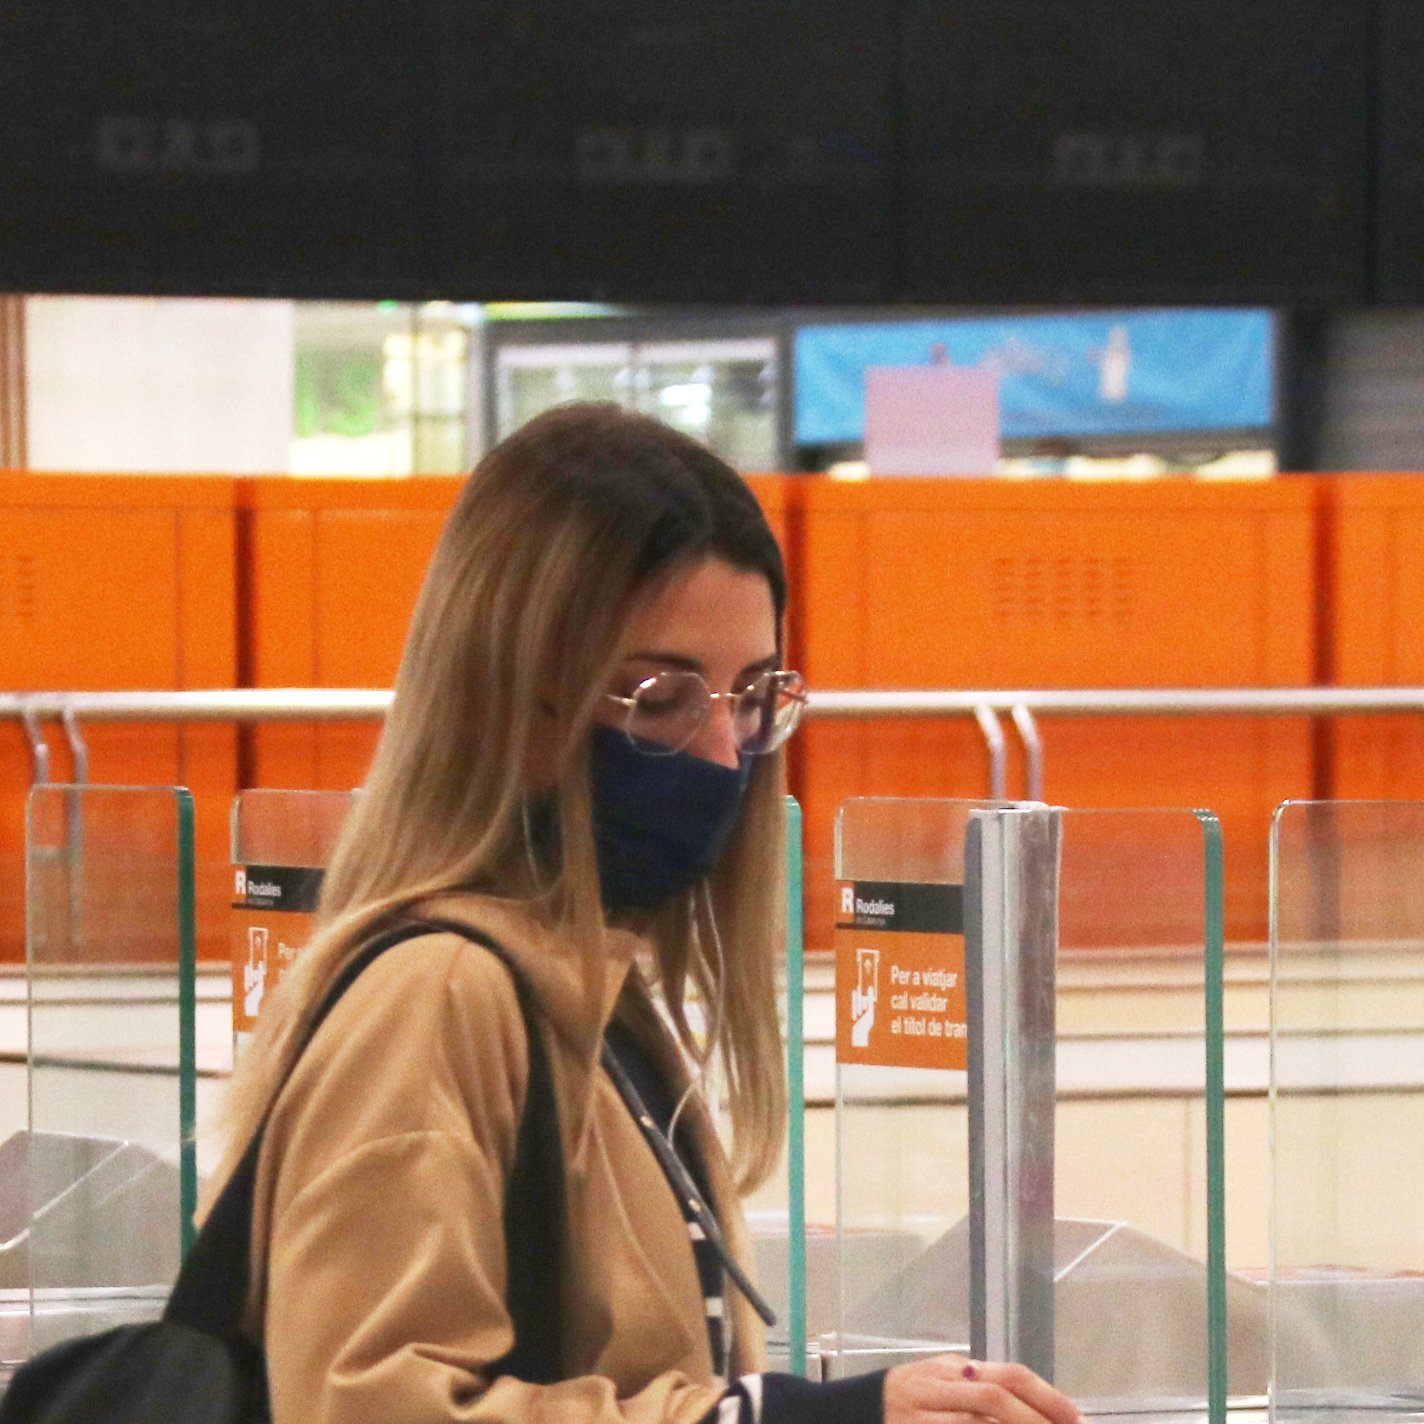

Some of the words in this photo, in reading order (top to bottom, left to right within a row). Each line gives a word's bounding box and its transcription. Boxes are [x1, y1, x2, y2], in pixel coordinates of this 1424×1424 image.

[235, 870, 246, 895] R
[248, 880, 281, 897] Rodalies
[841, 887, 854, 913] R
[856, 898, 895, 916] Rodalies
[890, 965, 910, 985] Per
[912, 971, 921, 985] a
[890, 991, 908, 1010] cal
[910, 992, 948, 1012] validar
[891, 1016, 902, 1035] el
[928, 1018, 943, 1037] de
[945, 1019, 967, 1039] tran
